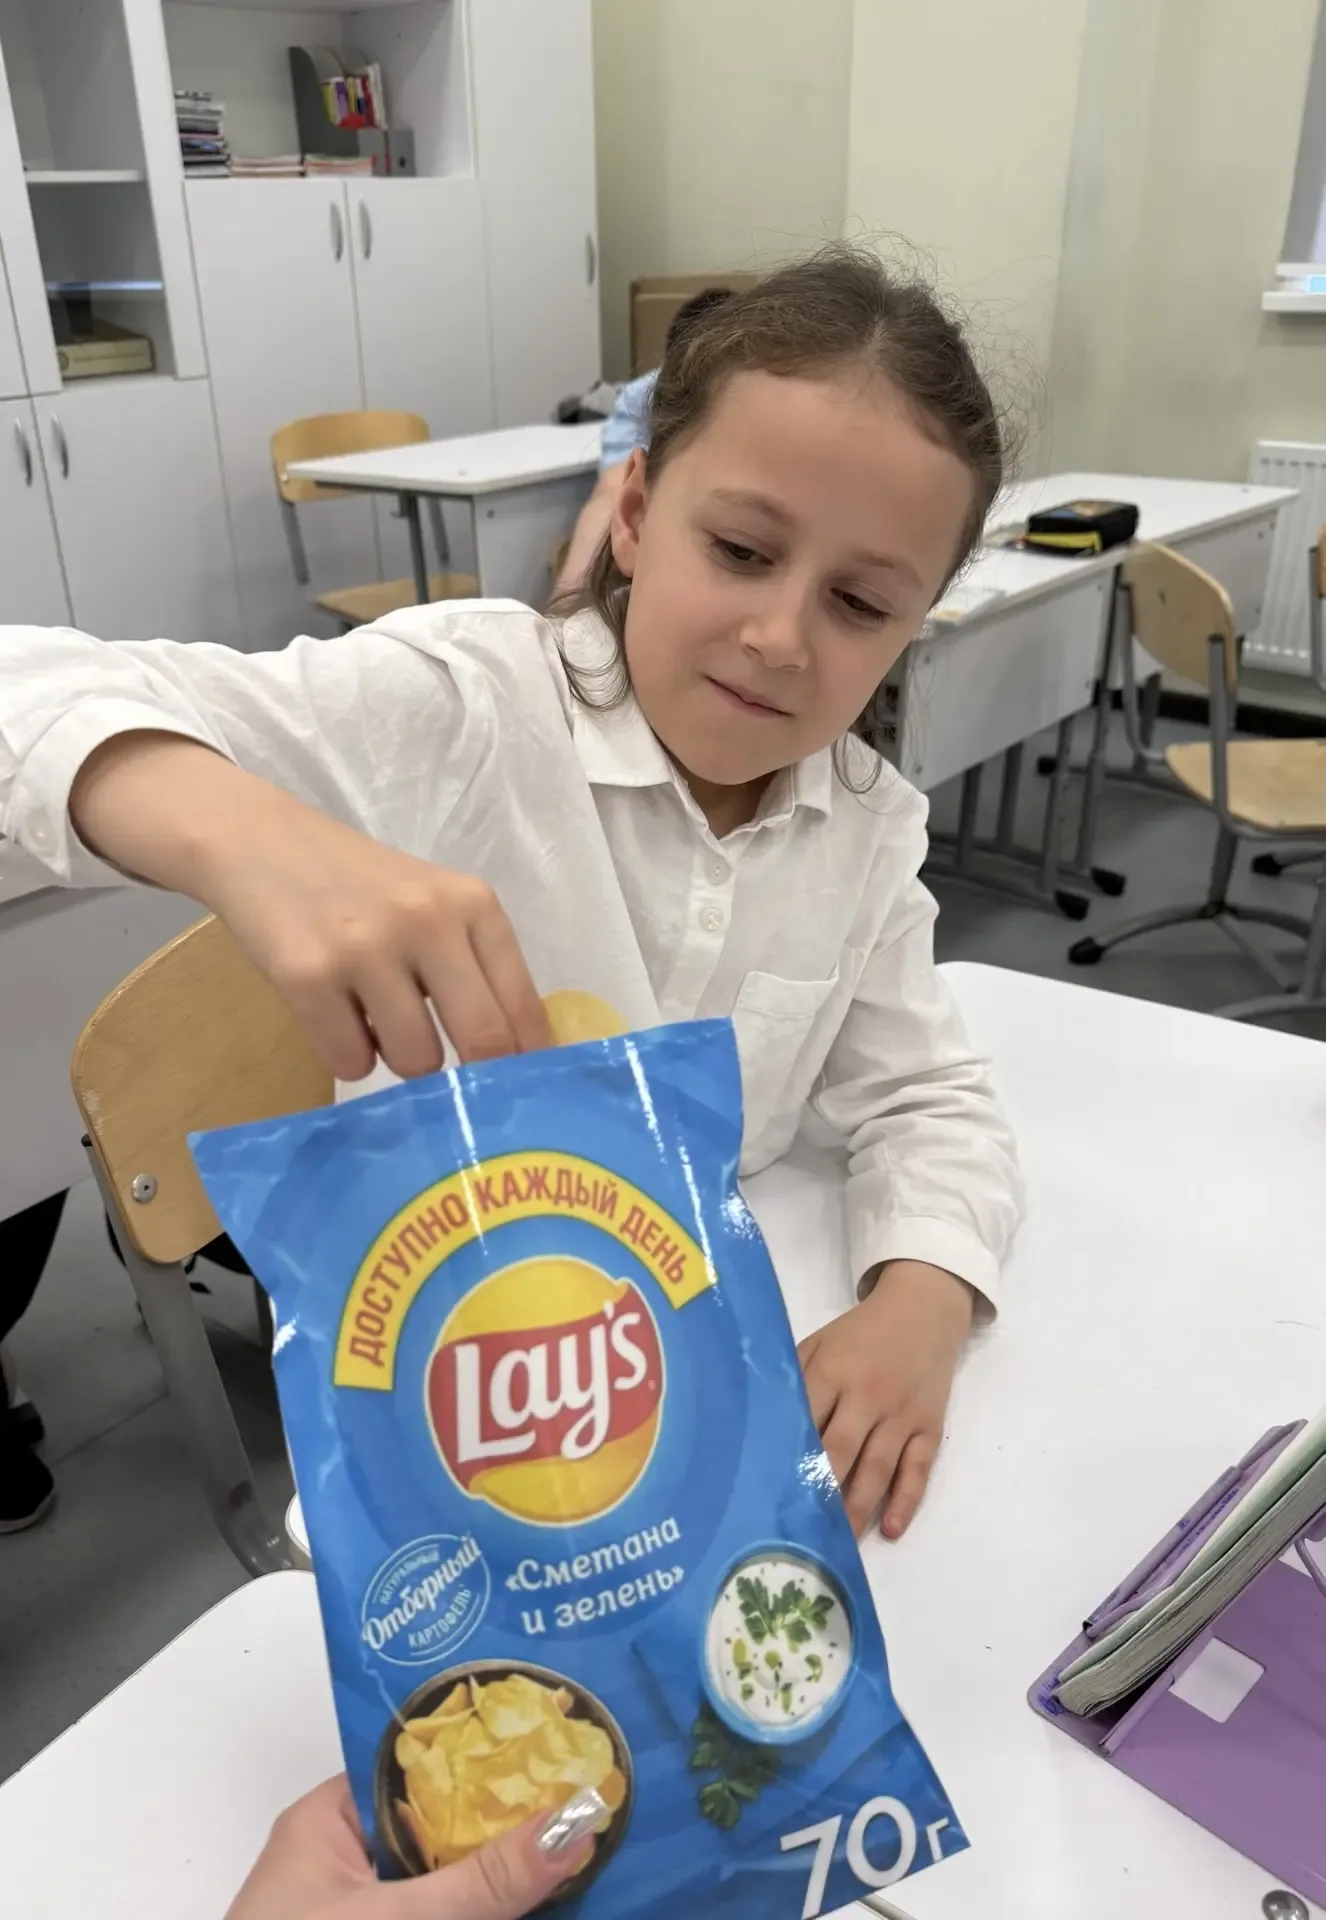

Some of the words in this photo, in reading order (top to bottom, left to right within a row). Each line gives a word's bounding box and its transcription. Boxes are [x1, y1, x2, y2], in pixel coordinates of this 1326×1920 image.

[350, 1192, 469, 1367] ДОСТУПНО
[474, 1166, 620, 1221] КАЖДЫЙ
[620, 1204, 688, 1285] ДЕНЬ
[455, 1300, 648, 1463] Lay's
[362, 1533, 482, 1650] Отборный
[505, 1517, 681, 1592] «Сметана
[521, 1609, 545, 1635] и
[554, 1566, 685, 1629] зелень»
[408, 1586, 472, 1648] КАРТОФЕЛЬ
